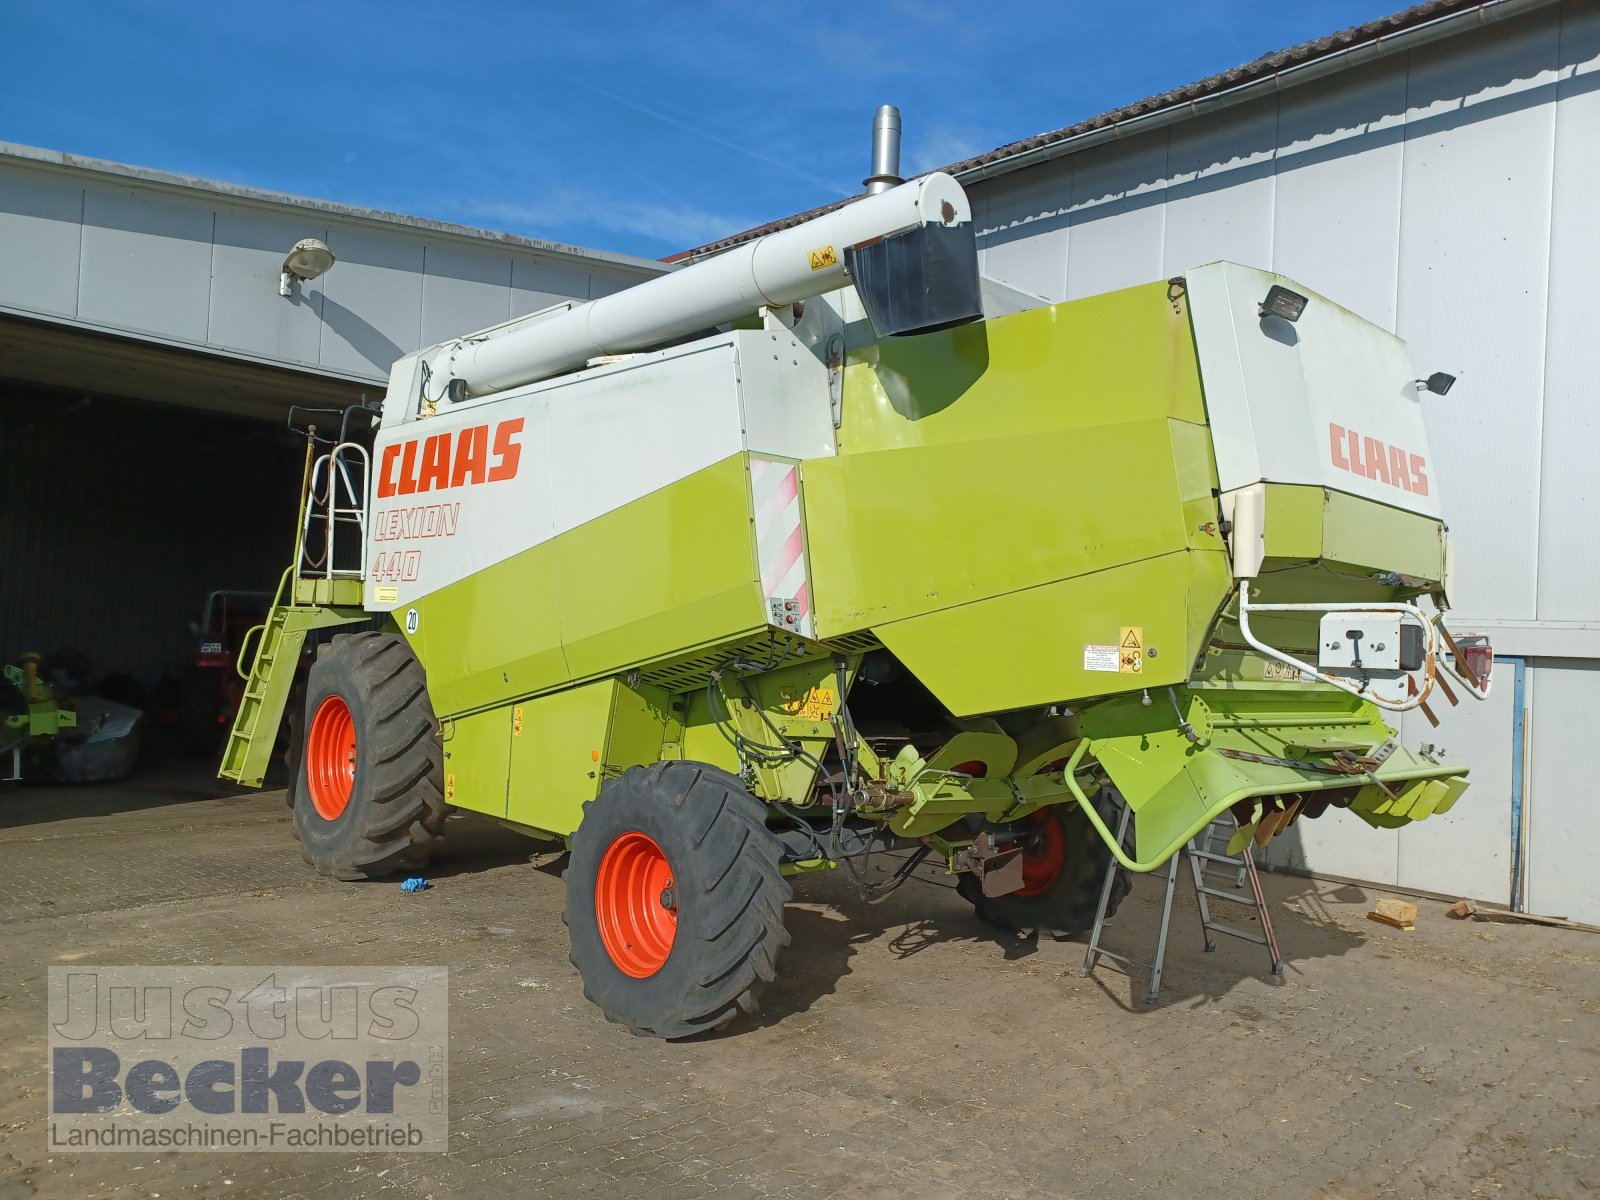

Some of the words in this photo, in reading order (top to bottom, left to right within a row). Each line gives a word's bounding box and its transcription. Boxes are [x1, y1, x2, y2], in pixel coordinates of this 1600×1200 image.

[377, 417, 525, 498] CLAAS
[1329, 422, 1429, 496] CLAAS
[374, 503, 460, 542] LEXION
[372, 550, 421, 582] 440
[408, 611, 417, 630] 20
[1093, 644, 1117, 652] DANGER
